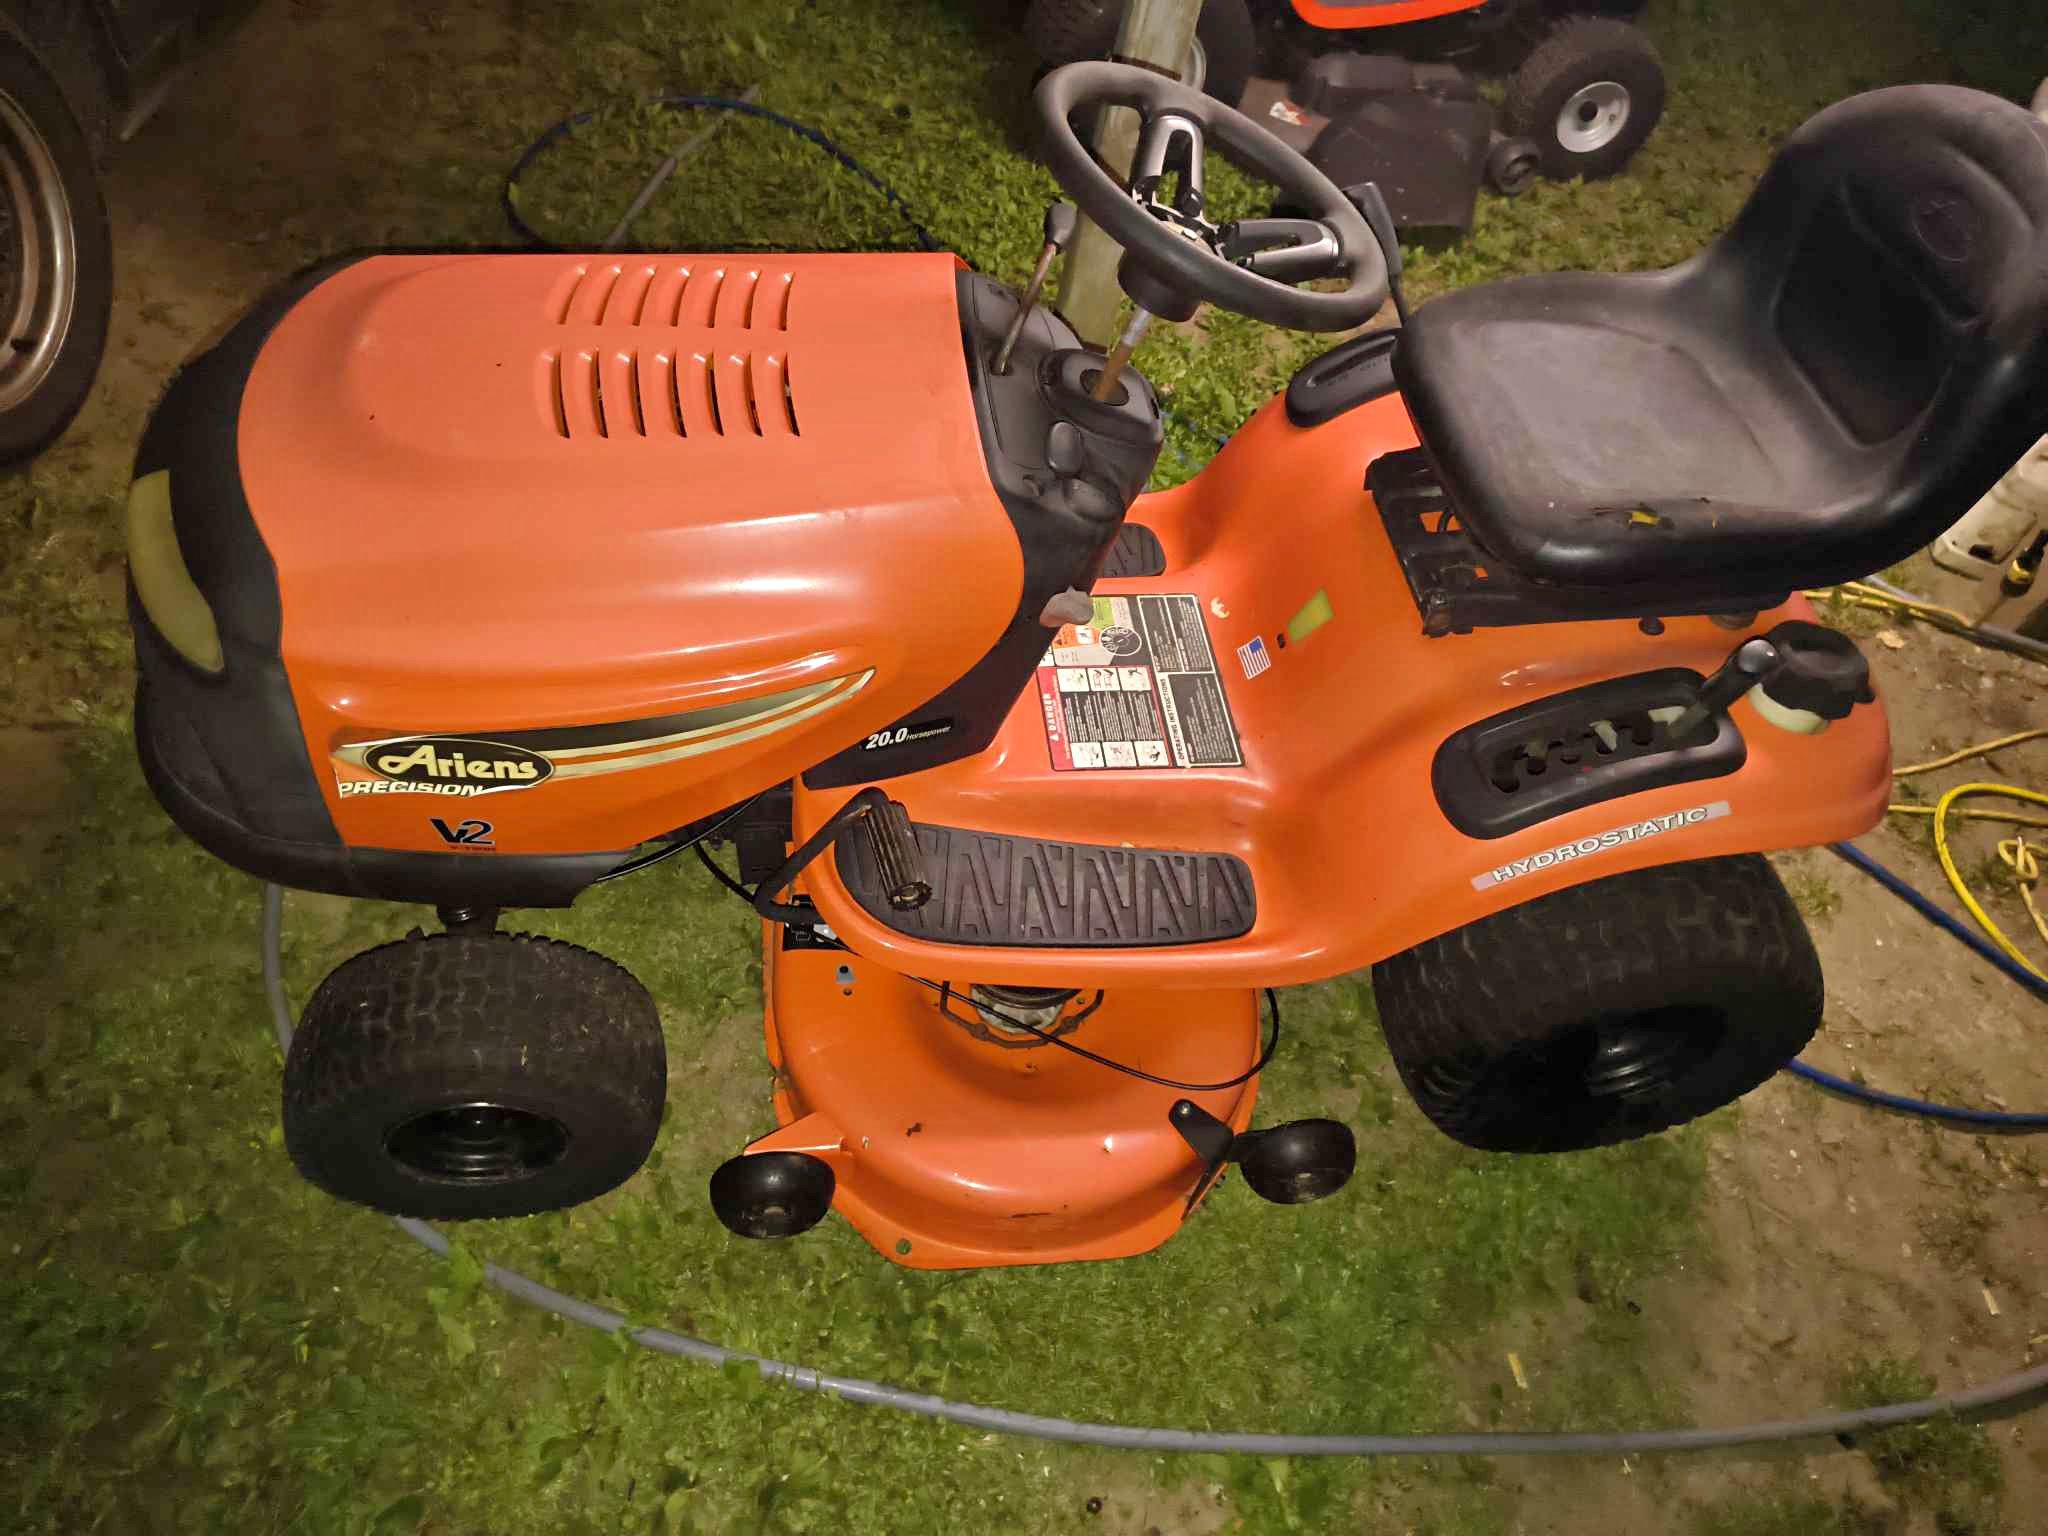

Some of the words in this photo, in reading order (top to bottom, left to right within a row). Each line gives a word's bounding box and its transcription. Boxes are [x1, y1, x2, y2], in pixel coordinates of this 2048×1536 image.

[1043, 693, 1057, 731] DANGER
[1160, 678, 1175, 723] INSTRUCTIONS
[865, 727, 908, 749] 20.0
[1170, 724, 1185, 760] OPERATING
[377, 744, 539, 779] Ariens
[339, 780, 484, 798] PRECISION
[429, 817, 496, 845] V2
[1492, 807, 1708, 882] HYDROSTATIC
